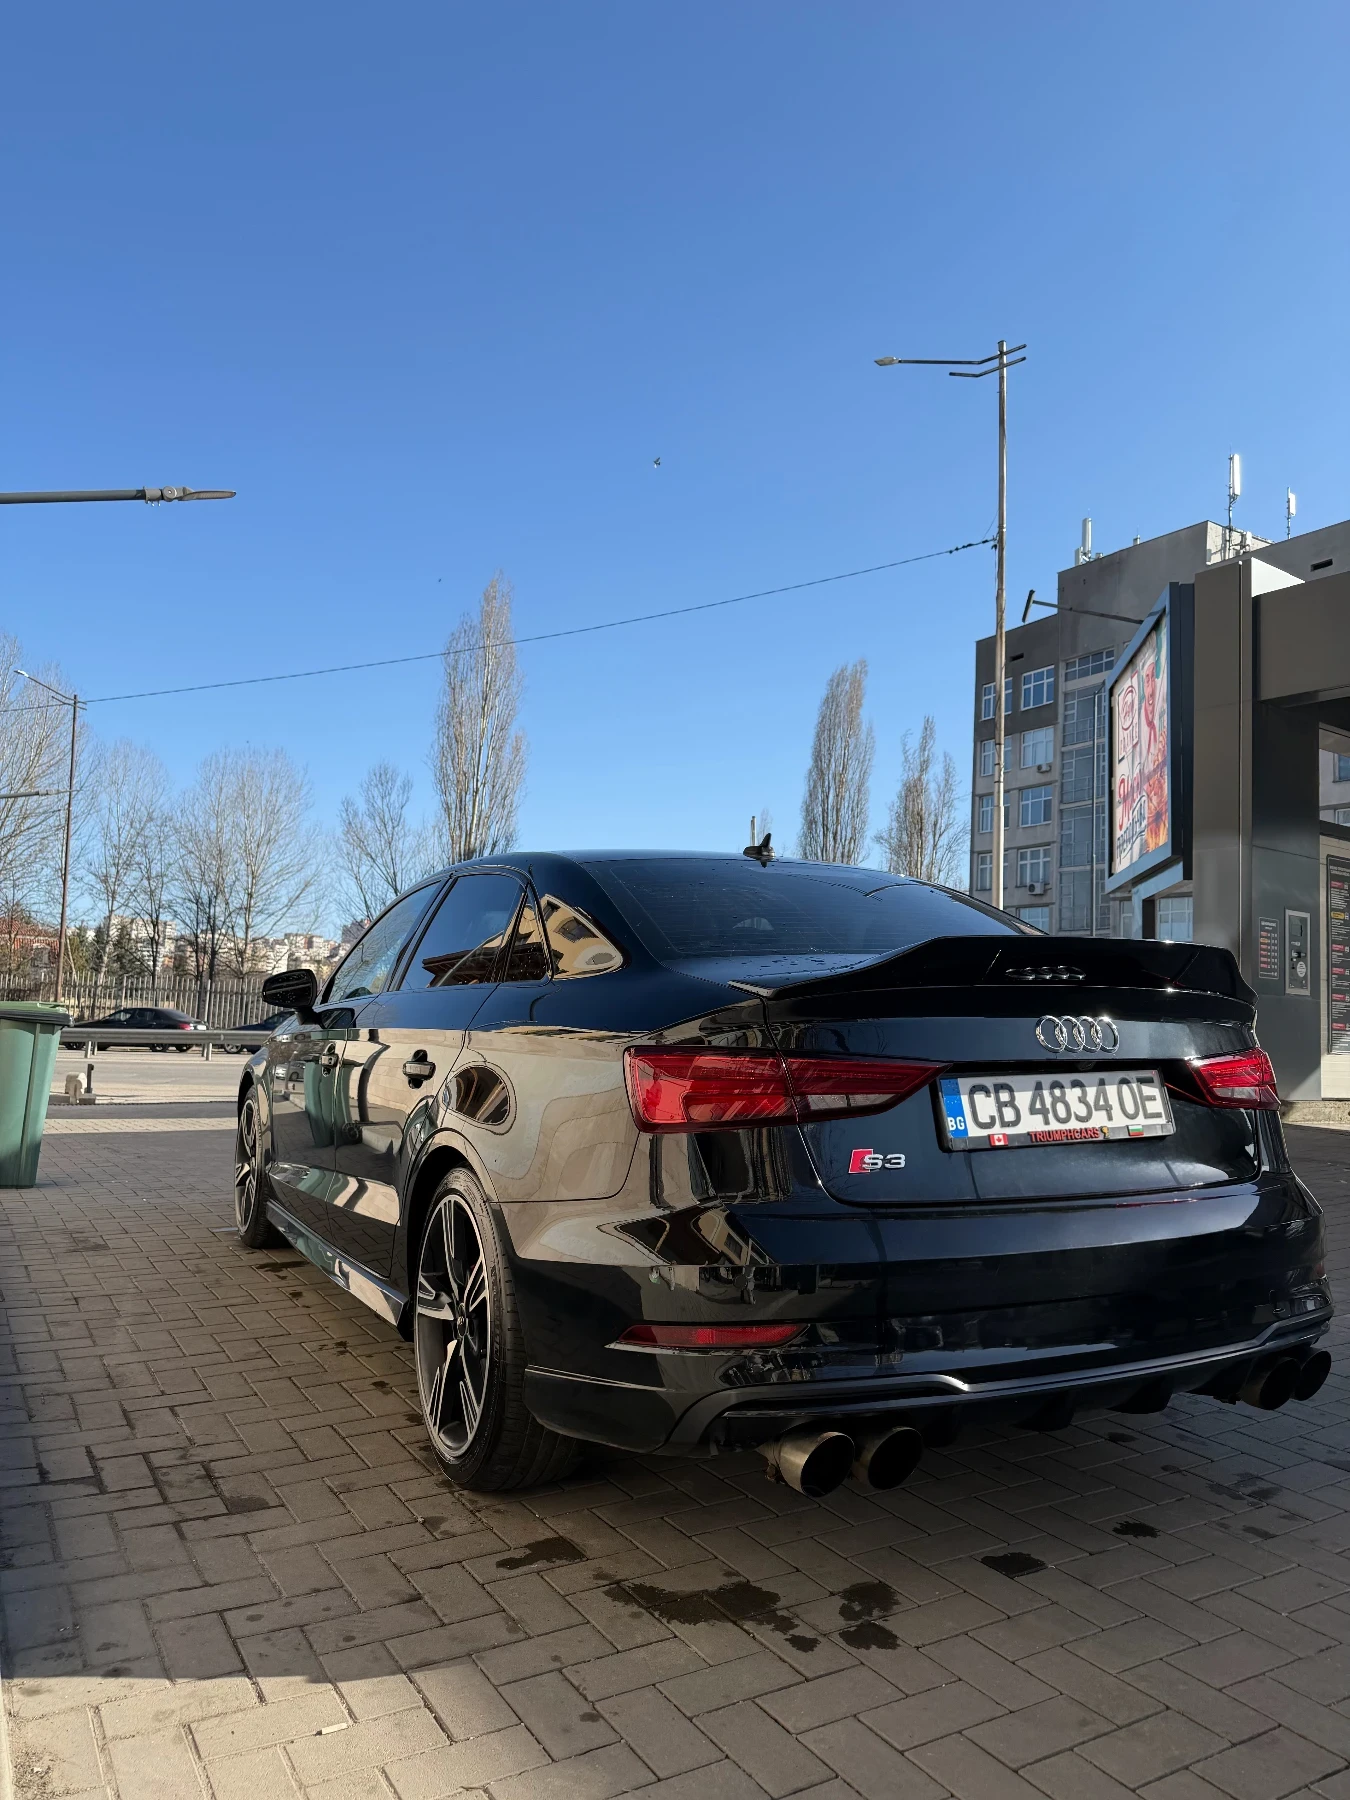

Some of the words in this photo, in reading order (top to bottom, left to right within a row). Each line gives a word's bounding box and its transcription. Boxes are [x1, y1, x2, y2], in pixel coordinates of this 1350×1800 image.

[968, 1082, 1022, 1129] CB
[1029, 1077, 1114, 1126] 4834
[1116, 1076, 1162, 1120] OE
[948, 1116, 965, 1131] BG
[1028, 1127, 1101, 1143] TRIUMPHCARS
[862, 1153, 906, 1170] S3
